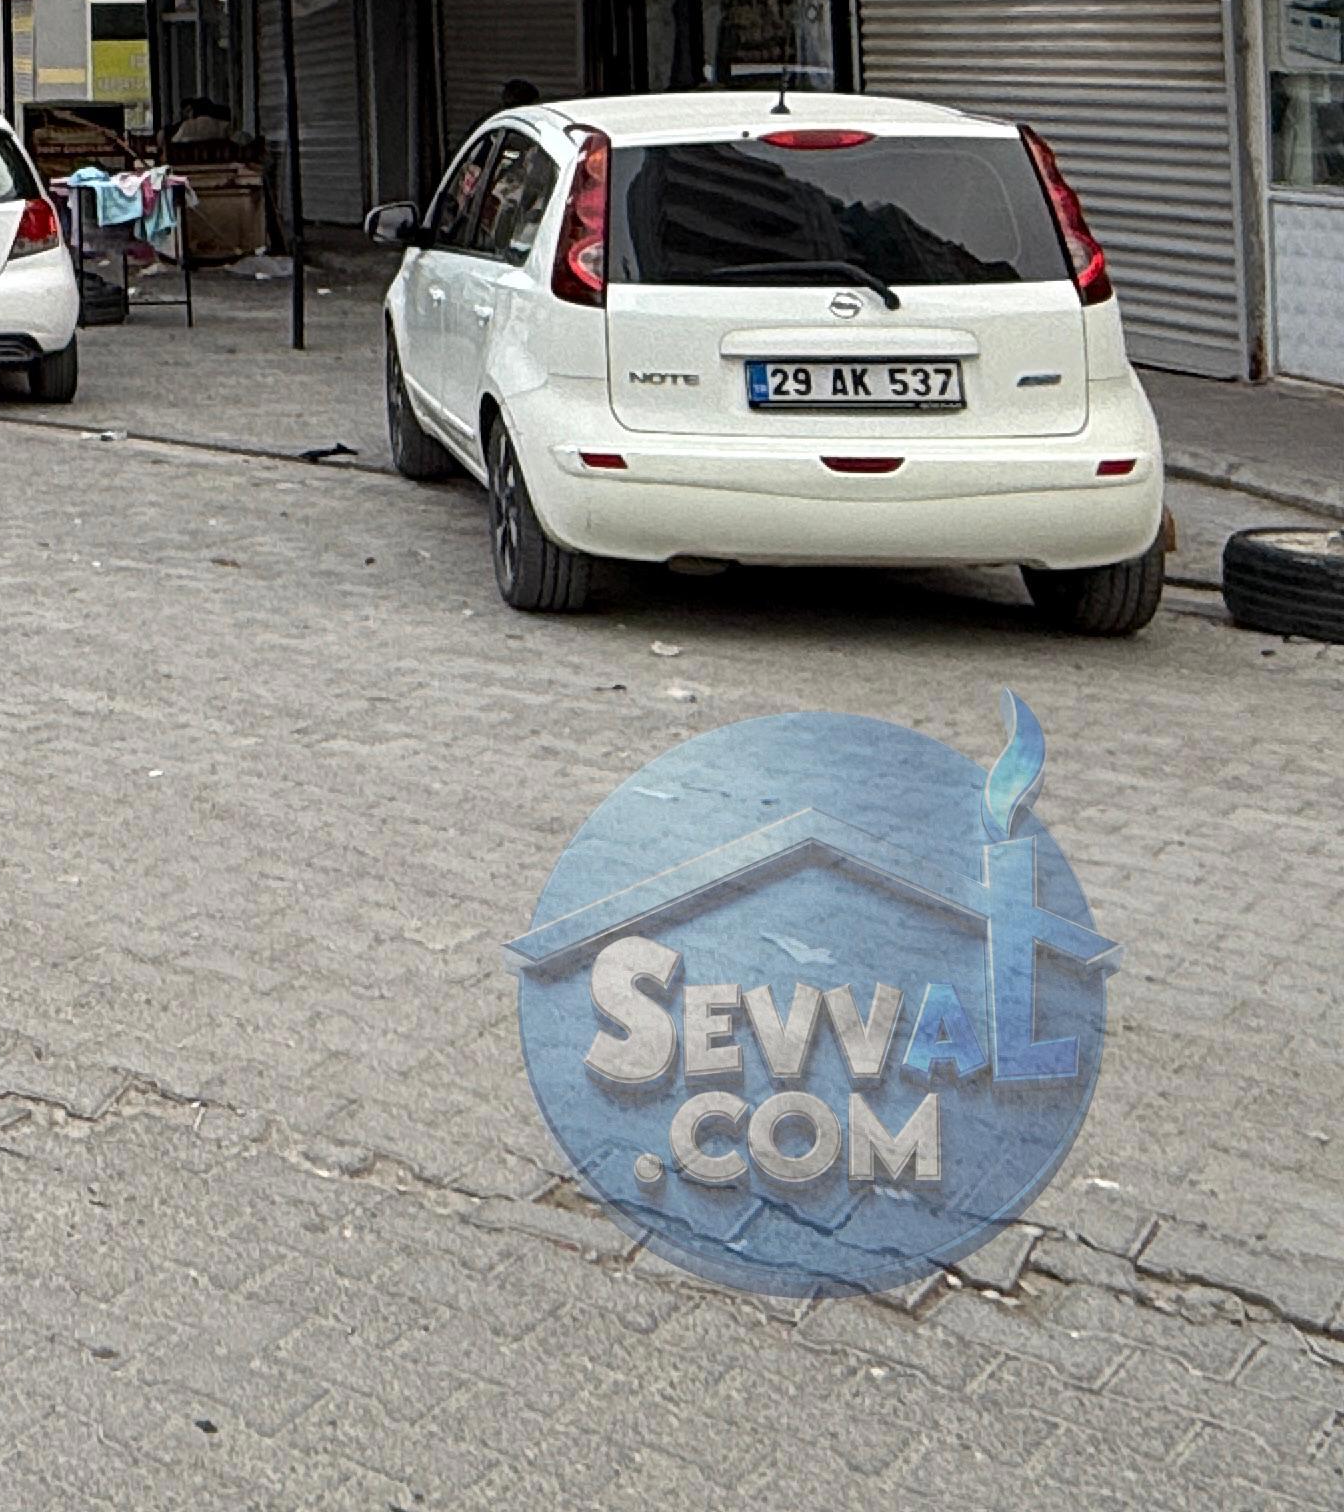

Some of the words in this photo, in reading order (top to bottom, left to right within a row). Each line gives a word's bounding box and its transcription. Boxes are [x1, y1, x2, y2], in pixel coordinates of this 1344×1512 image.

[628, 370, 700, 386] NOTE
[770, 368, 812, 396] 29
[831, 368, 872, 396] AK
[888, 368, 953, 396] 537
